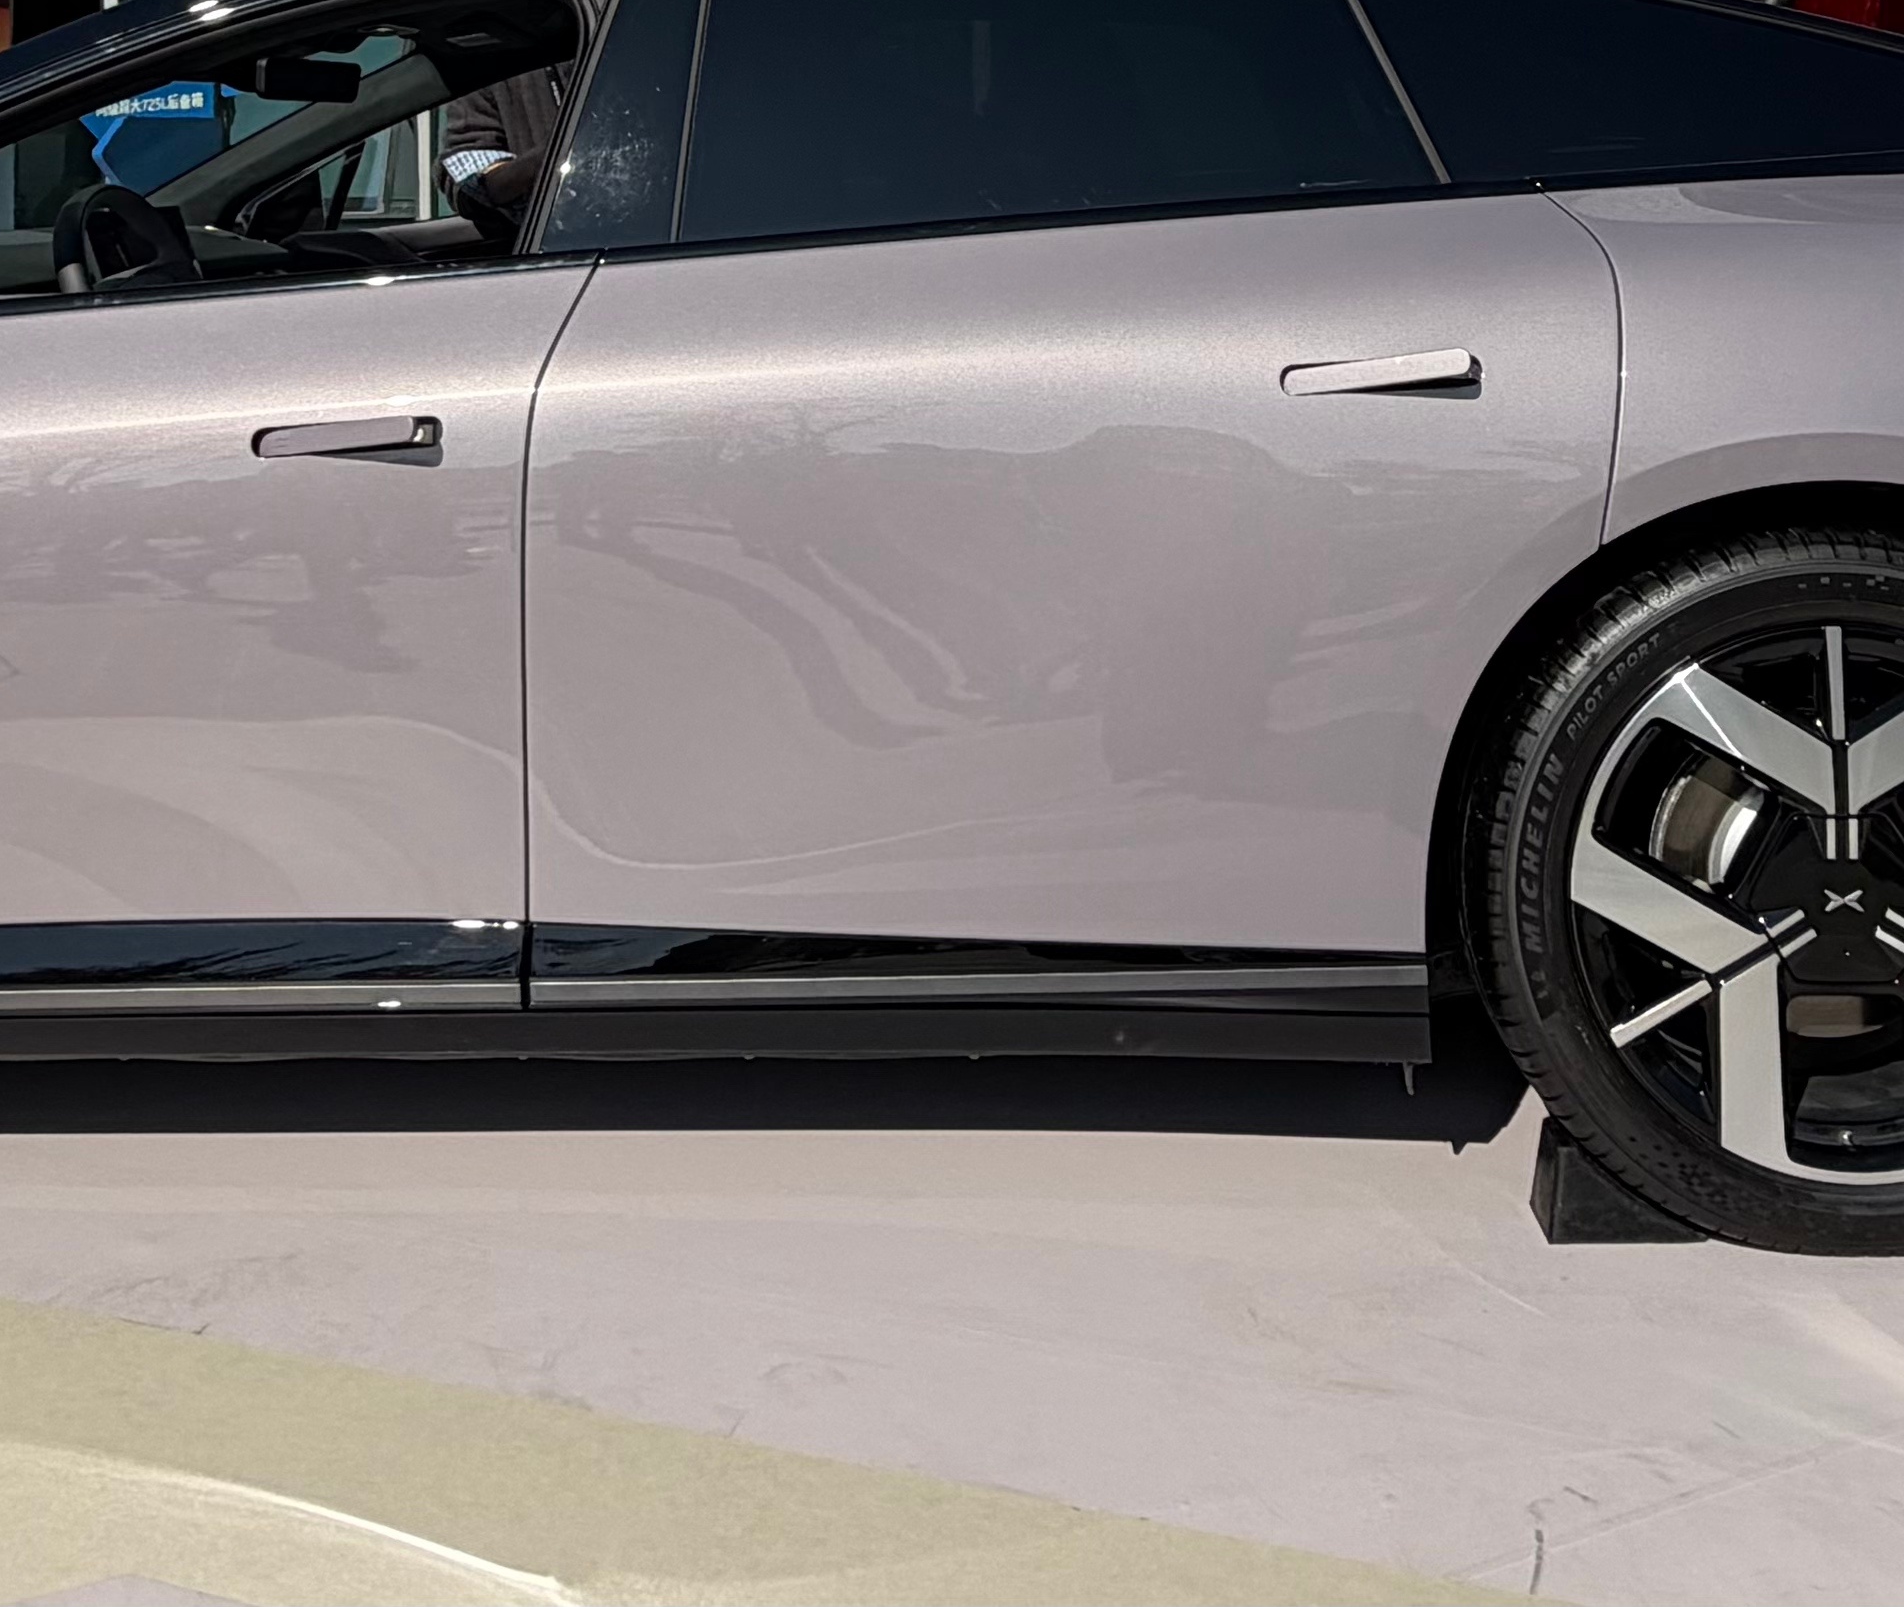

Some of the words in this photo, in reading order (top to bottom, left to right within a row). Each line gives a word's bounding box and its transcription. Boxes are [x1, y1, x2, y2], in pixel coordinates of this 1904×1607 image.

[1565, 685, 1605, 742] PILOT
[1605, 631, 1663, 691] SPORT
[1517, 751, 1566, 954] MICHELIN
